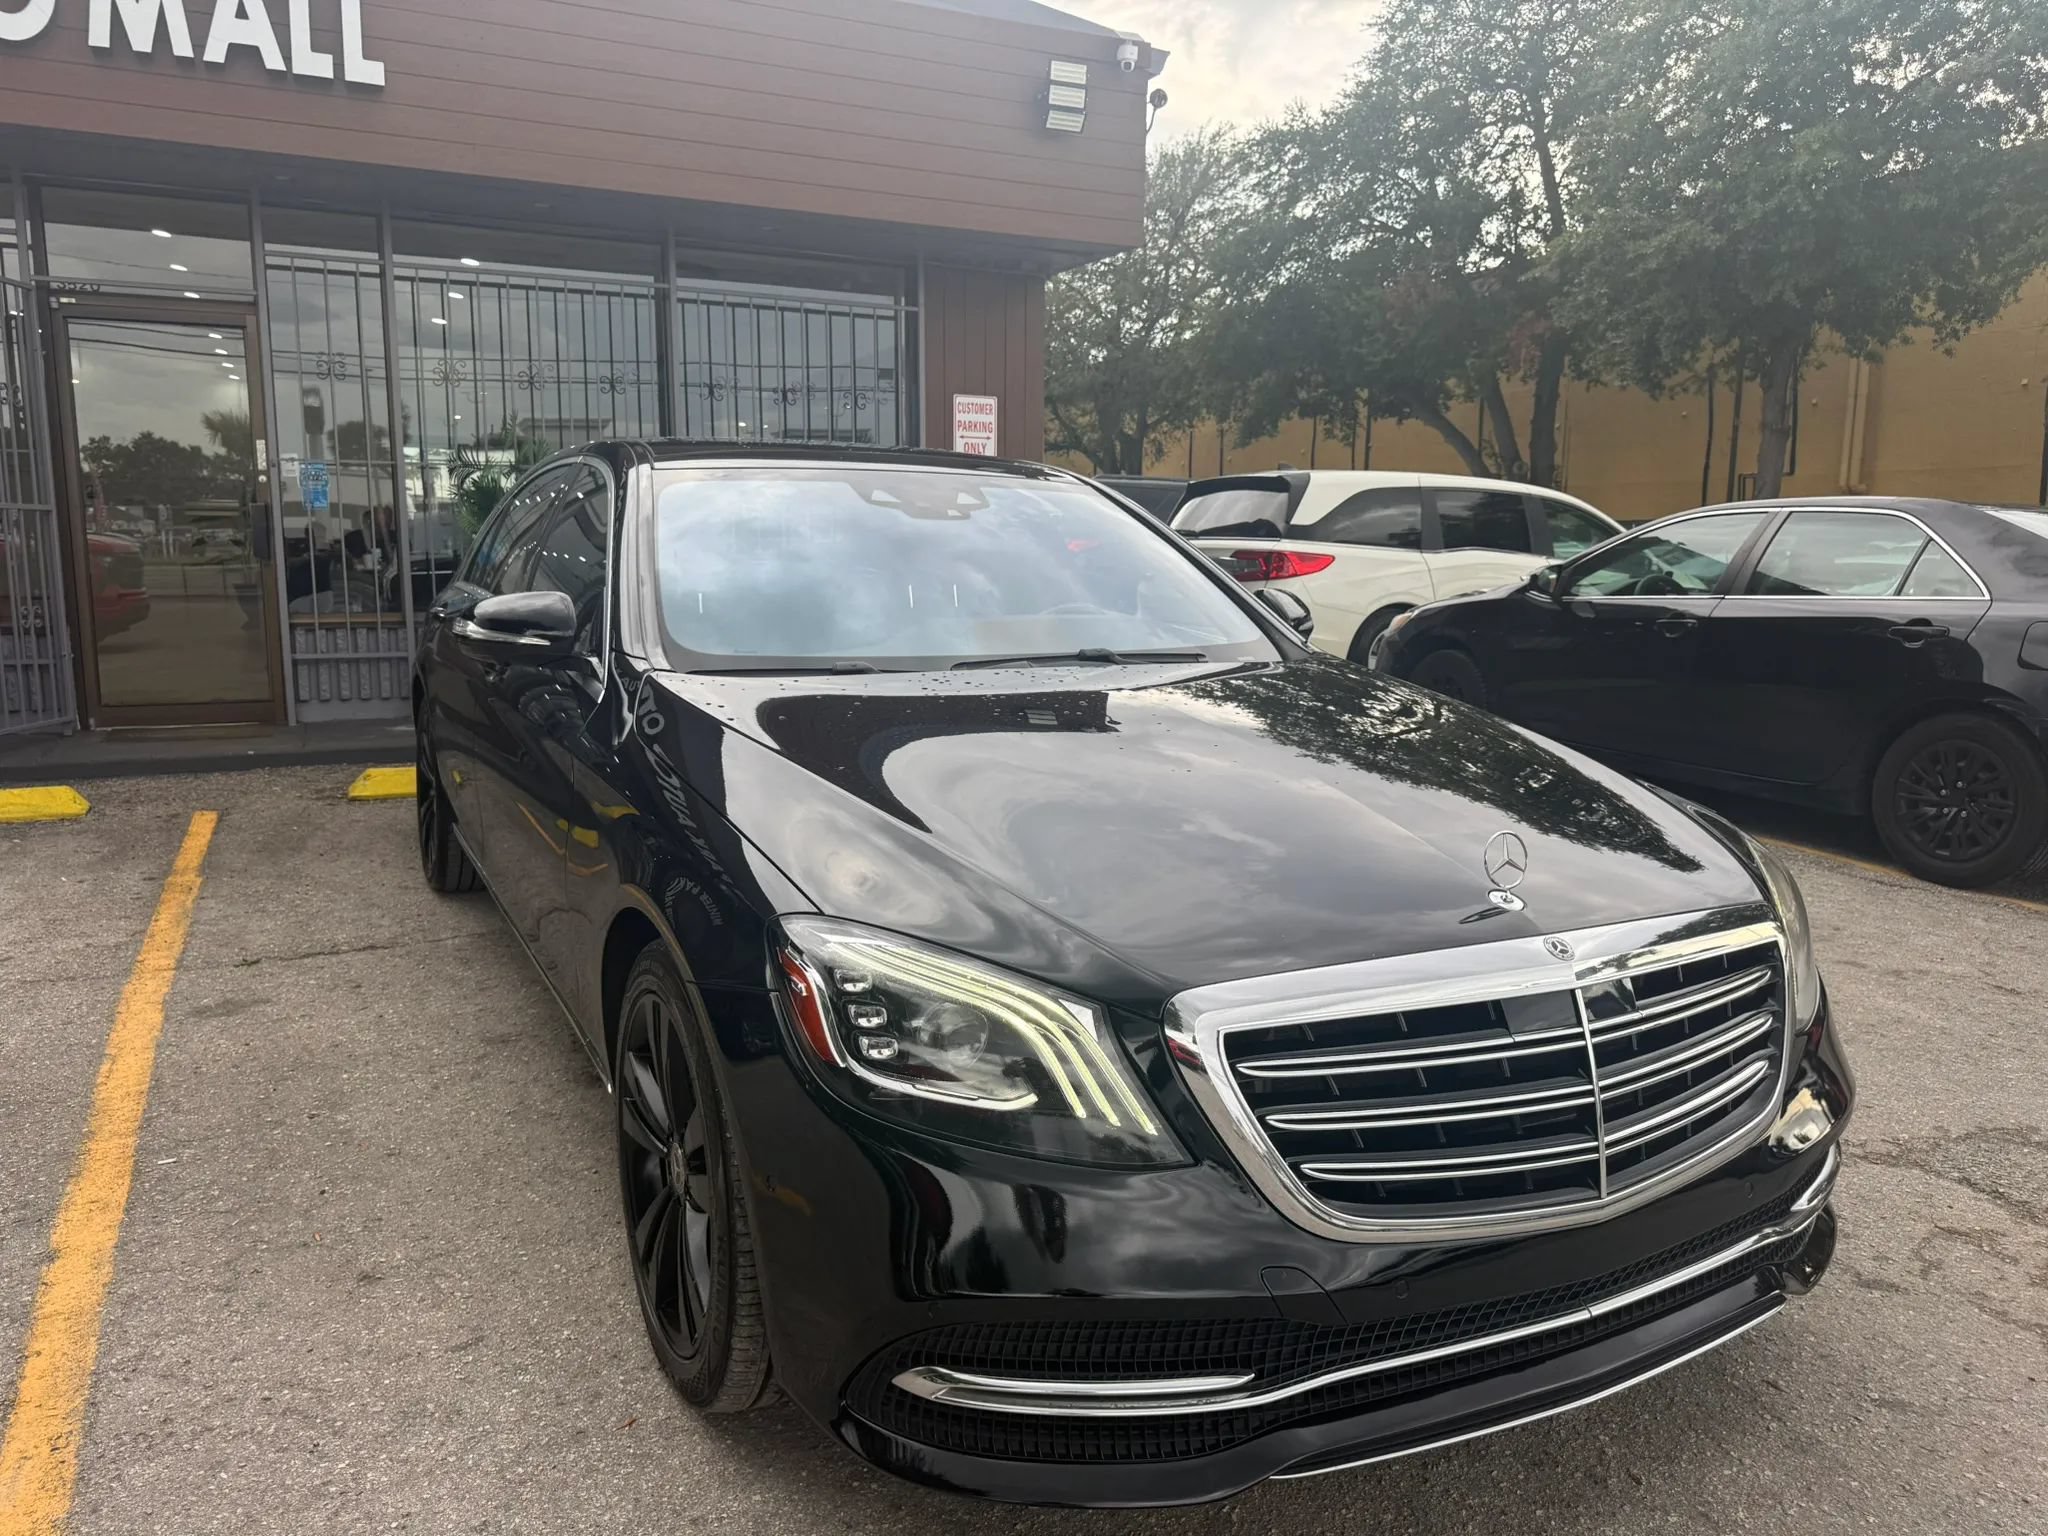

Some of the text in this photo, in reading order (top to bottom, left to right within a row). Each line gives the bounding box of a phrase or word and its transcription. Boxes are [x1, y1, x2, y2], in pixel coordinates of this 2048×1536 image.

[88, 0, 386, 87] MALL
[957, 401, 993, 416] CUSTOMER
[957, 420, 993, 433] PARKING
[963, 442, 987, 455] ONLY
